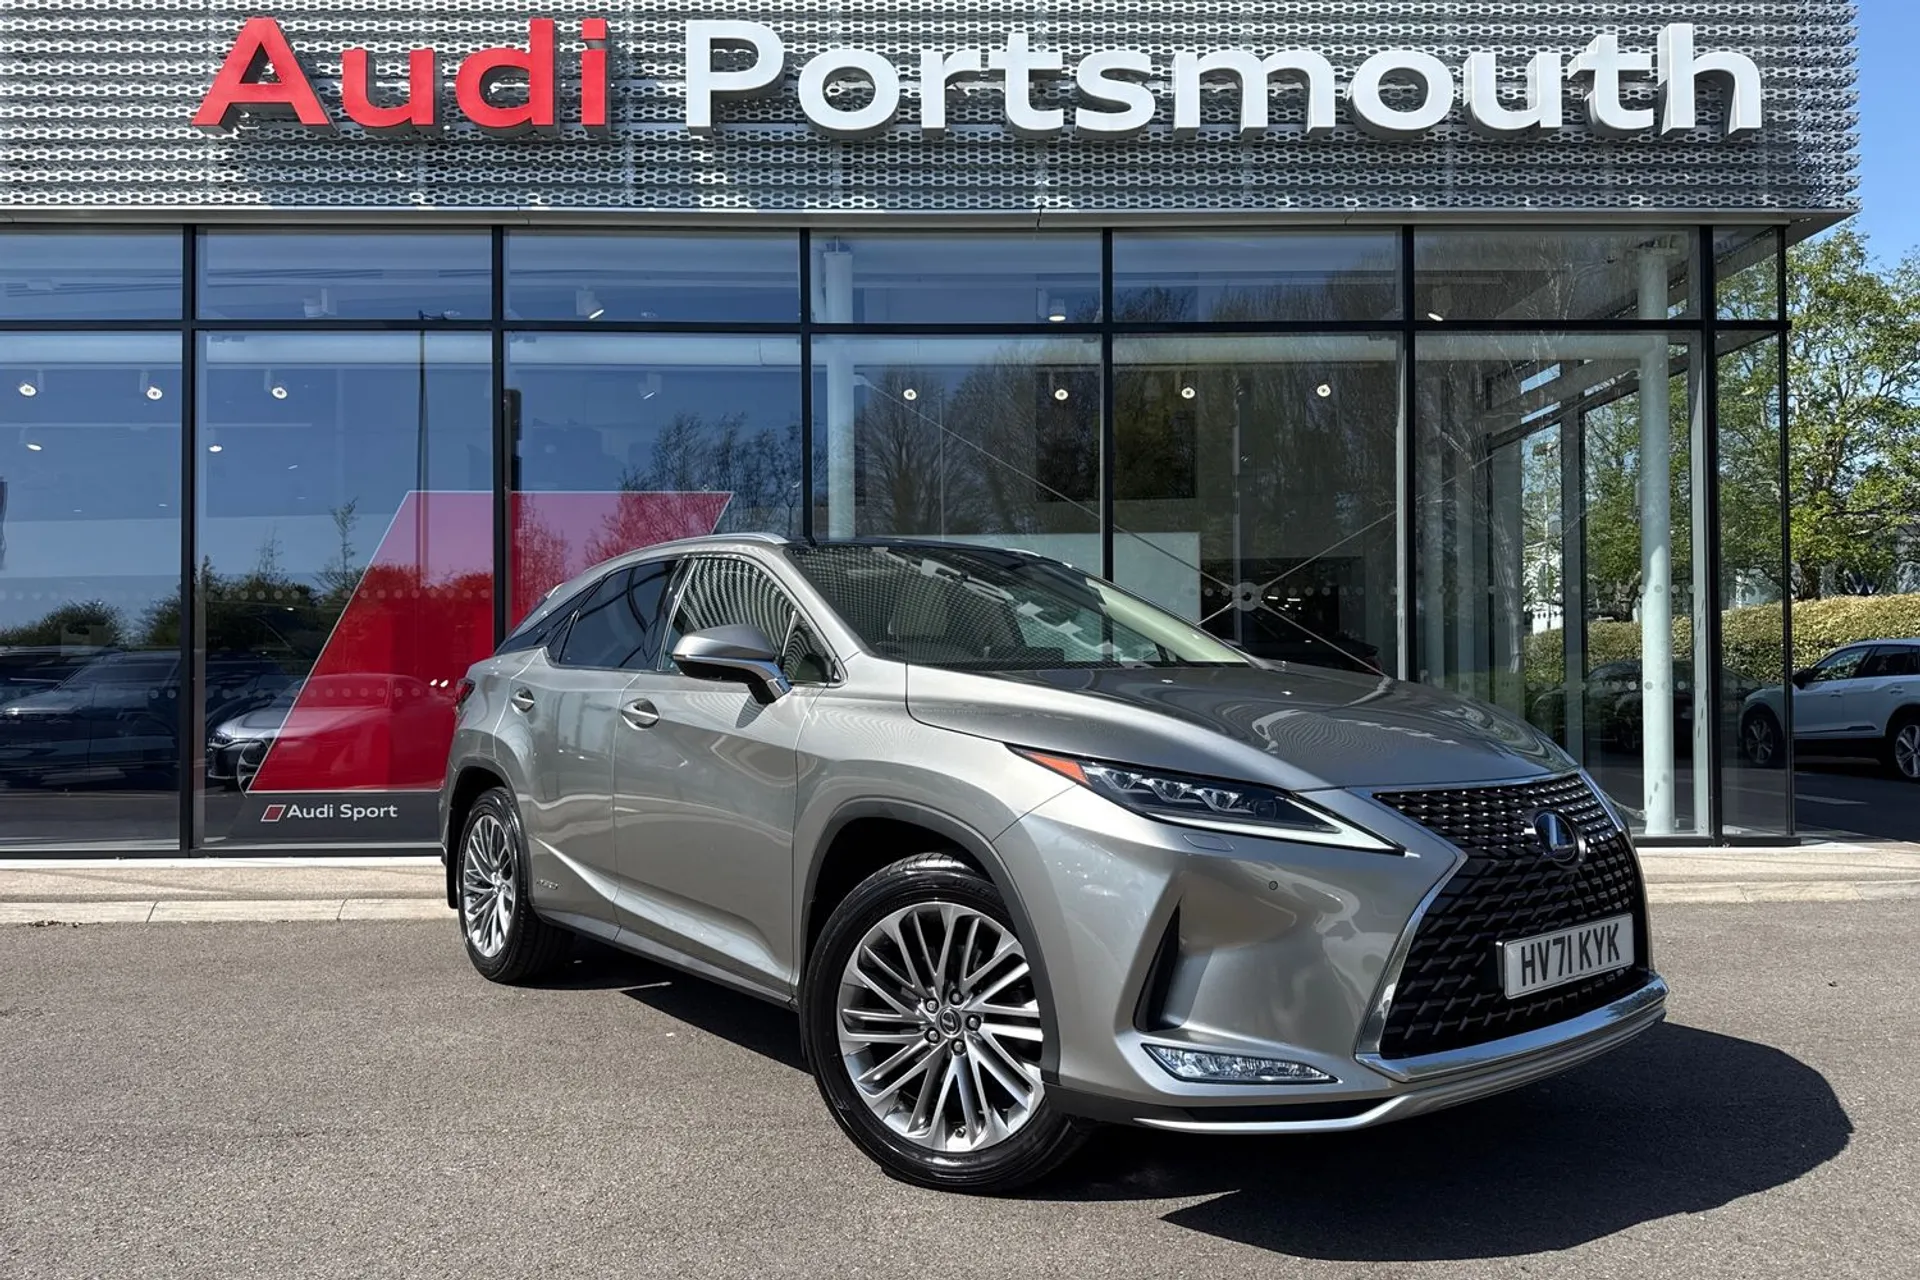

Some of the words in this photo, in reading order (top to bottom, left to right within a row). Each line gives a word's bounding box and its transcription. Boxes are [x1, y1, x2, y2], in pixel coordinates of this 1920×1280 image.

[192, 17, 607, 128] Audi
[685, 19, 1762, 133] Portsmouth
[287, 804, 333, 818] Audi
[340, 804, 398, 821] Sport
[1521, 935, 1573, 986] HV71
[1578, 923, 1621, 970] KYK
